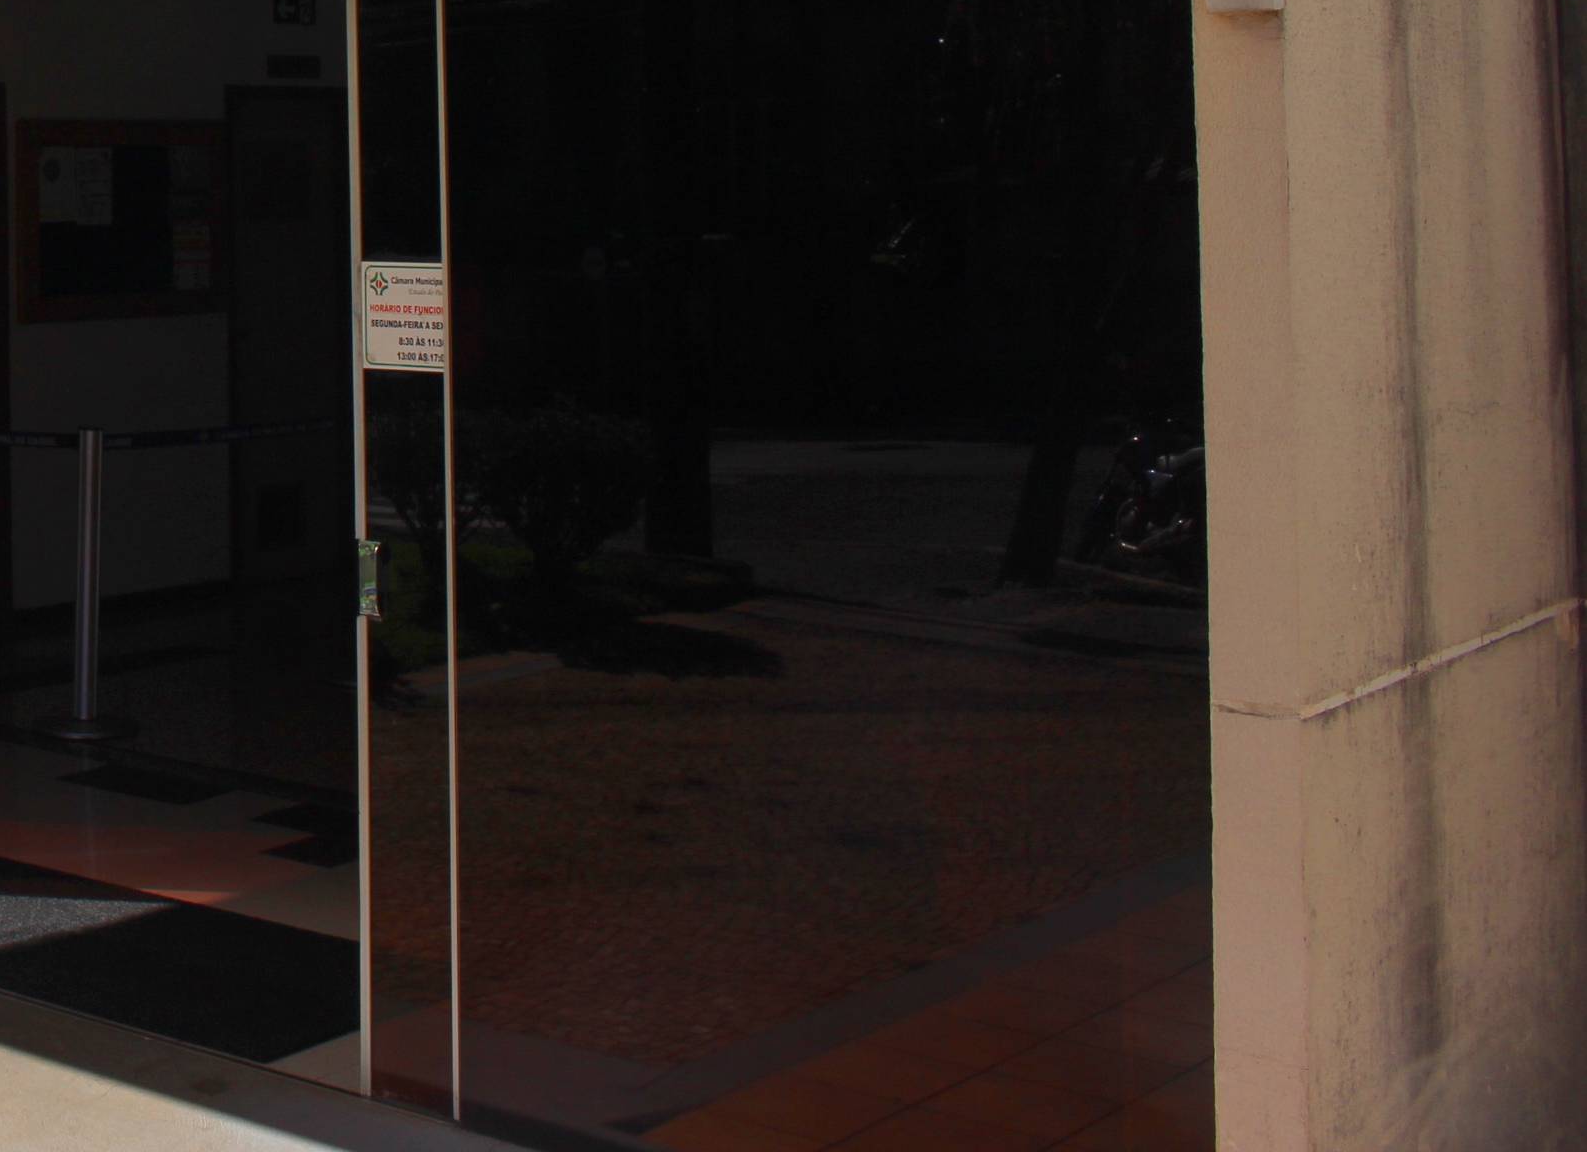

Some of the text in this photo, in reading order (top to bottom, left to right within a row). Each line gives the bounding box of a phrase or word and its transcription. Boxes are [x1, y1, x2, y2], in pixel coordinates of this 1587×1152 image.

[390, 276, 414, 285] Câmara
[403, 305, 413, 313] DE
[414, 306, 444, 315] FUNCIO
[371, 319, 424, 330] SEGUNDA-FEIRA
[427, 338, 444, 347] 11:3
